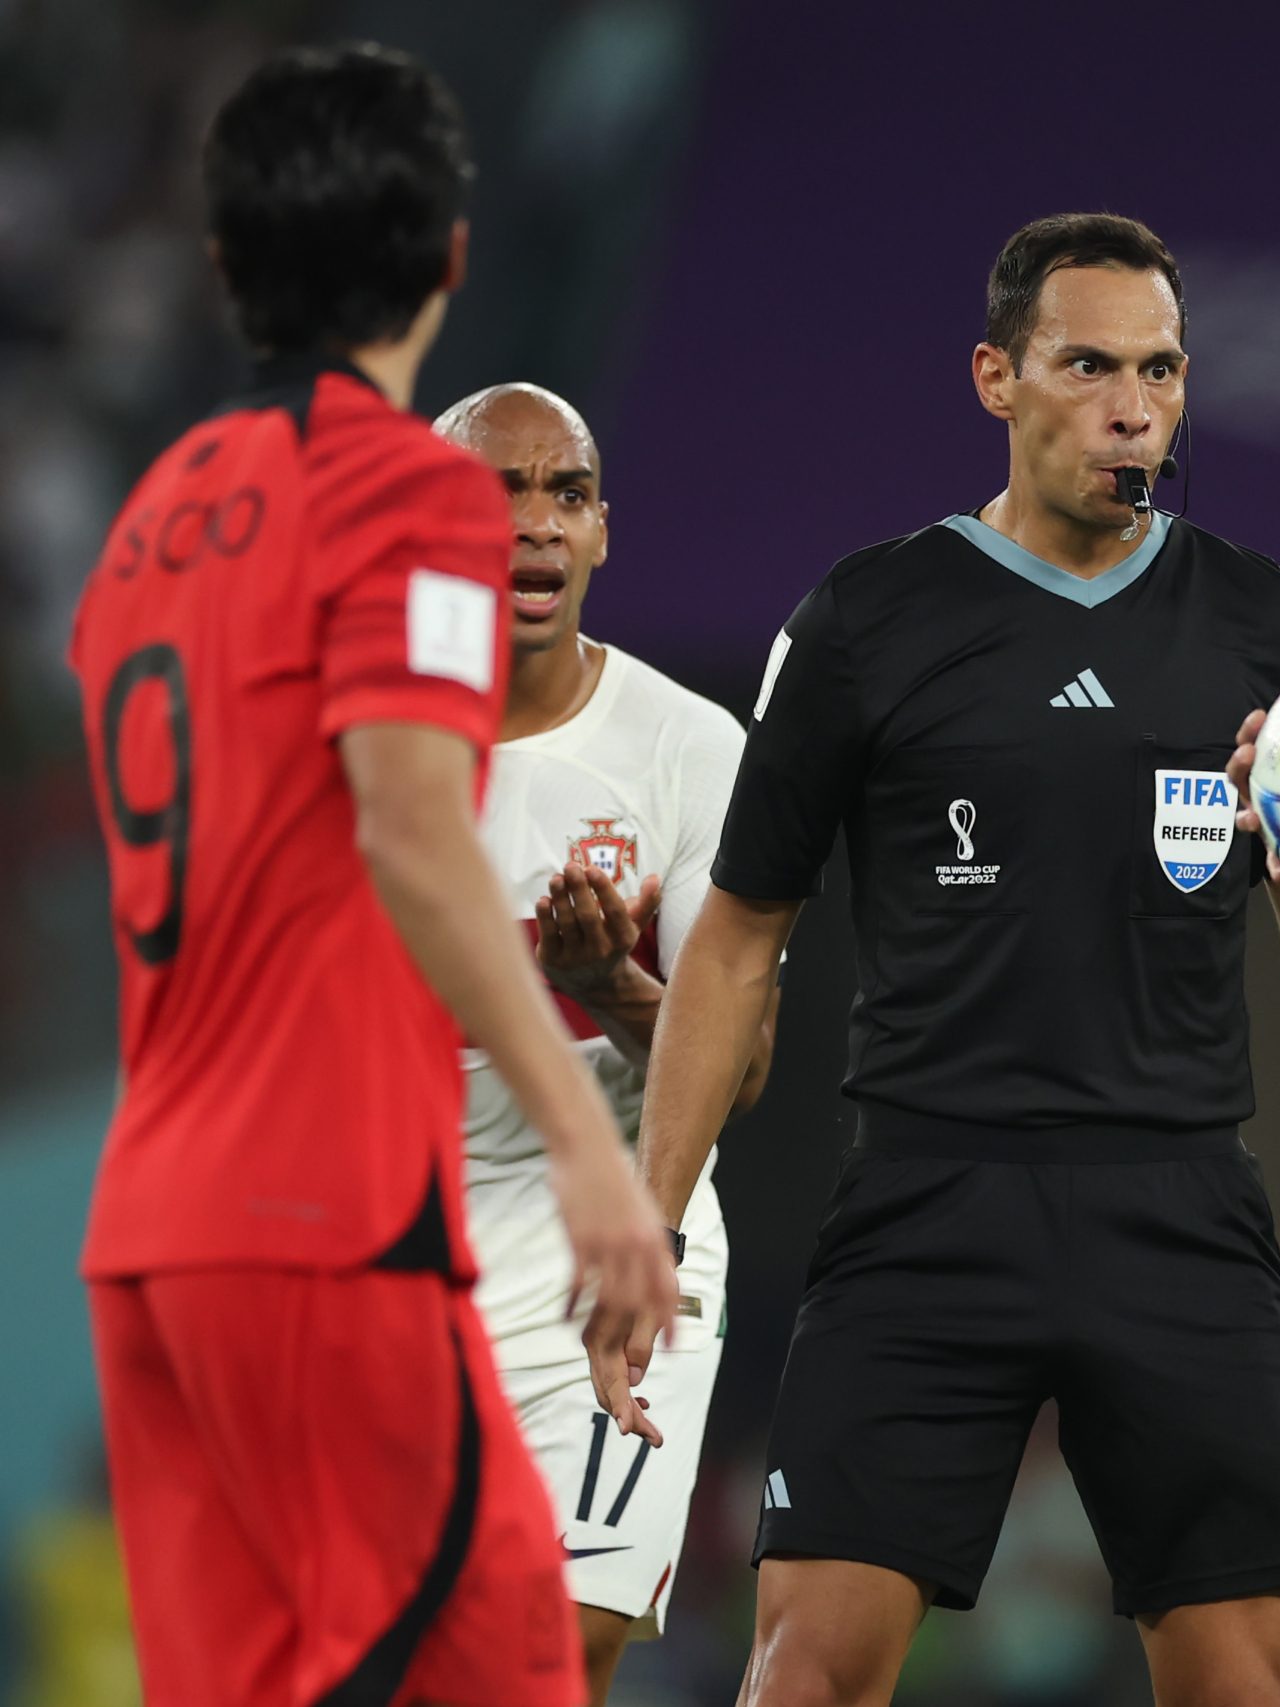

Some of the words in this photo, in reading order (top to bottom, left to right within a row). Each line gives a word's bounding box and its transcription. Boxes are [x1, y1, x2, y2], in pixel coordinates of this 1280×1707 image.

[1164, 777, 1230, 807] FIFA
[104, 643, 190, 964] 9
[1162, 826, 1227, 842] REFEREE
[935, 866, 951, 874] FIFA
[951, 866, 982, 874] WORLD
[983, 865, 1001, 873] CUP
[1175, 865, 1206, 880] 2022
